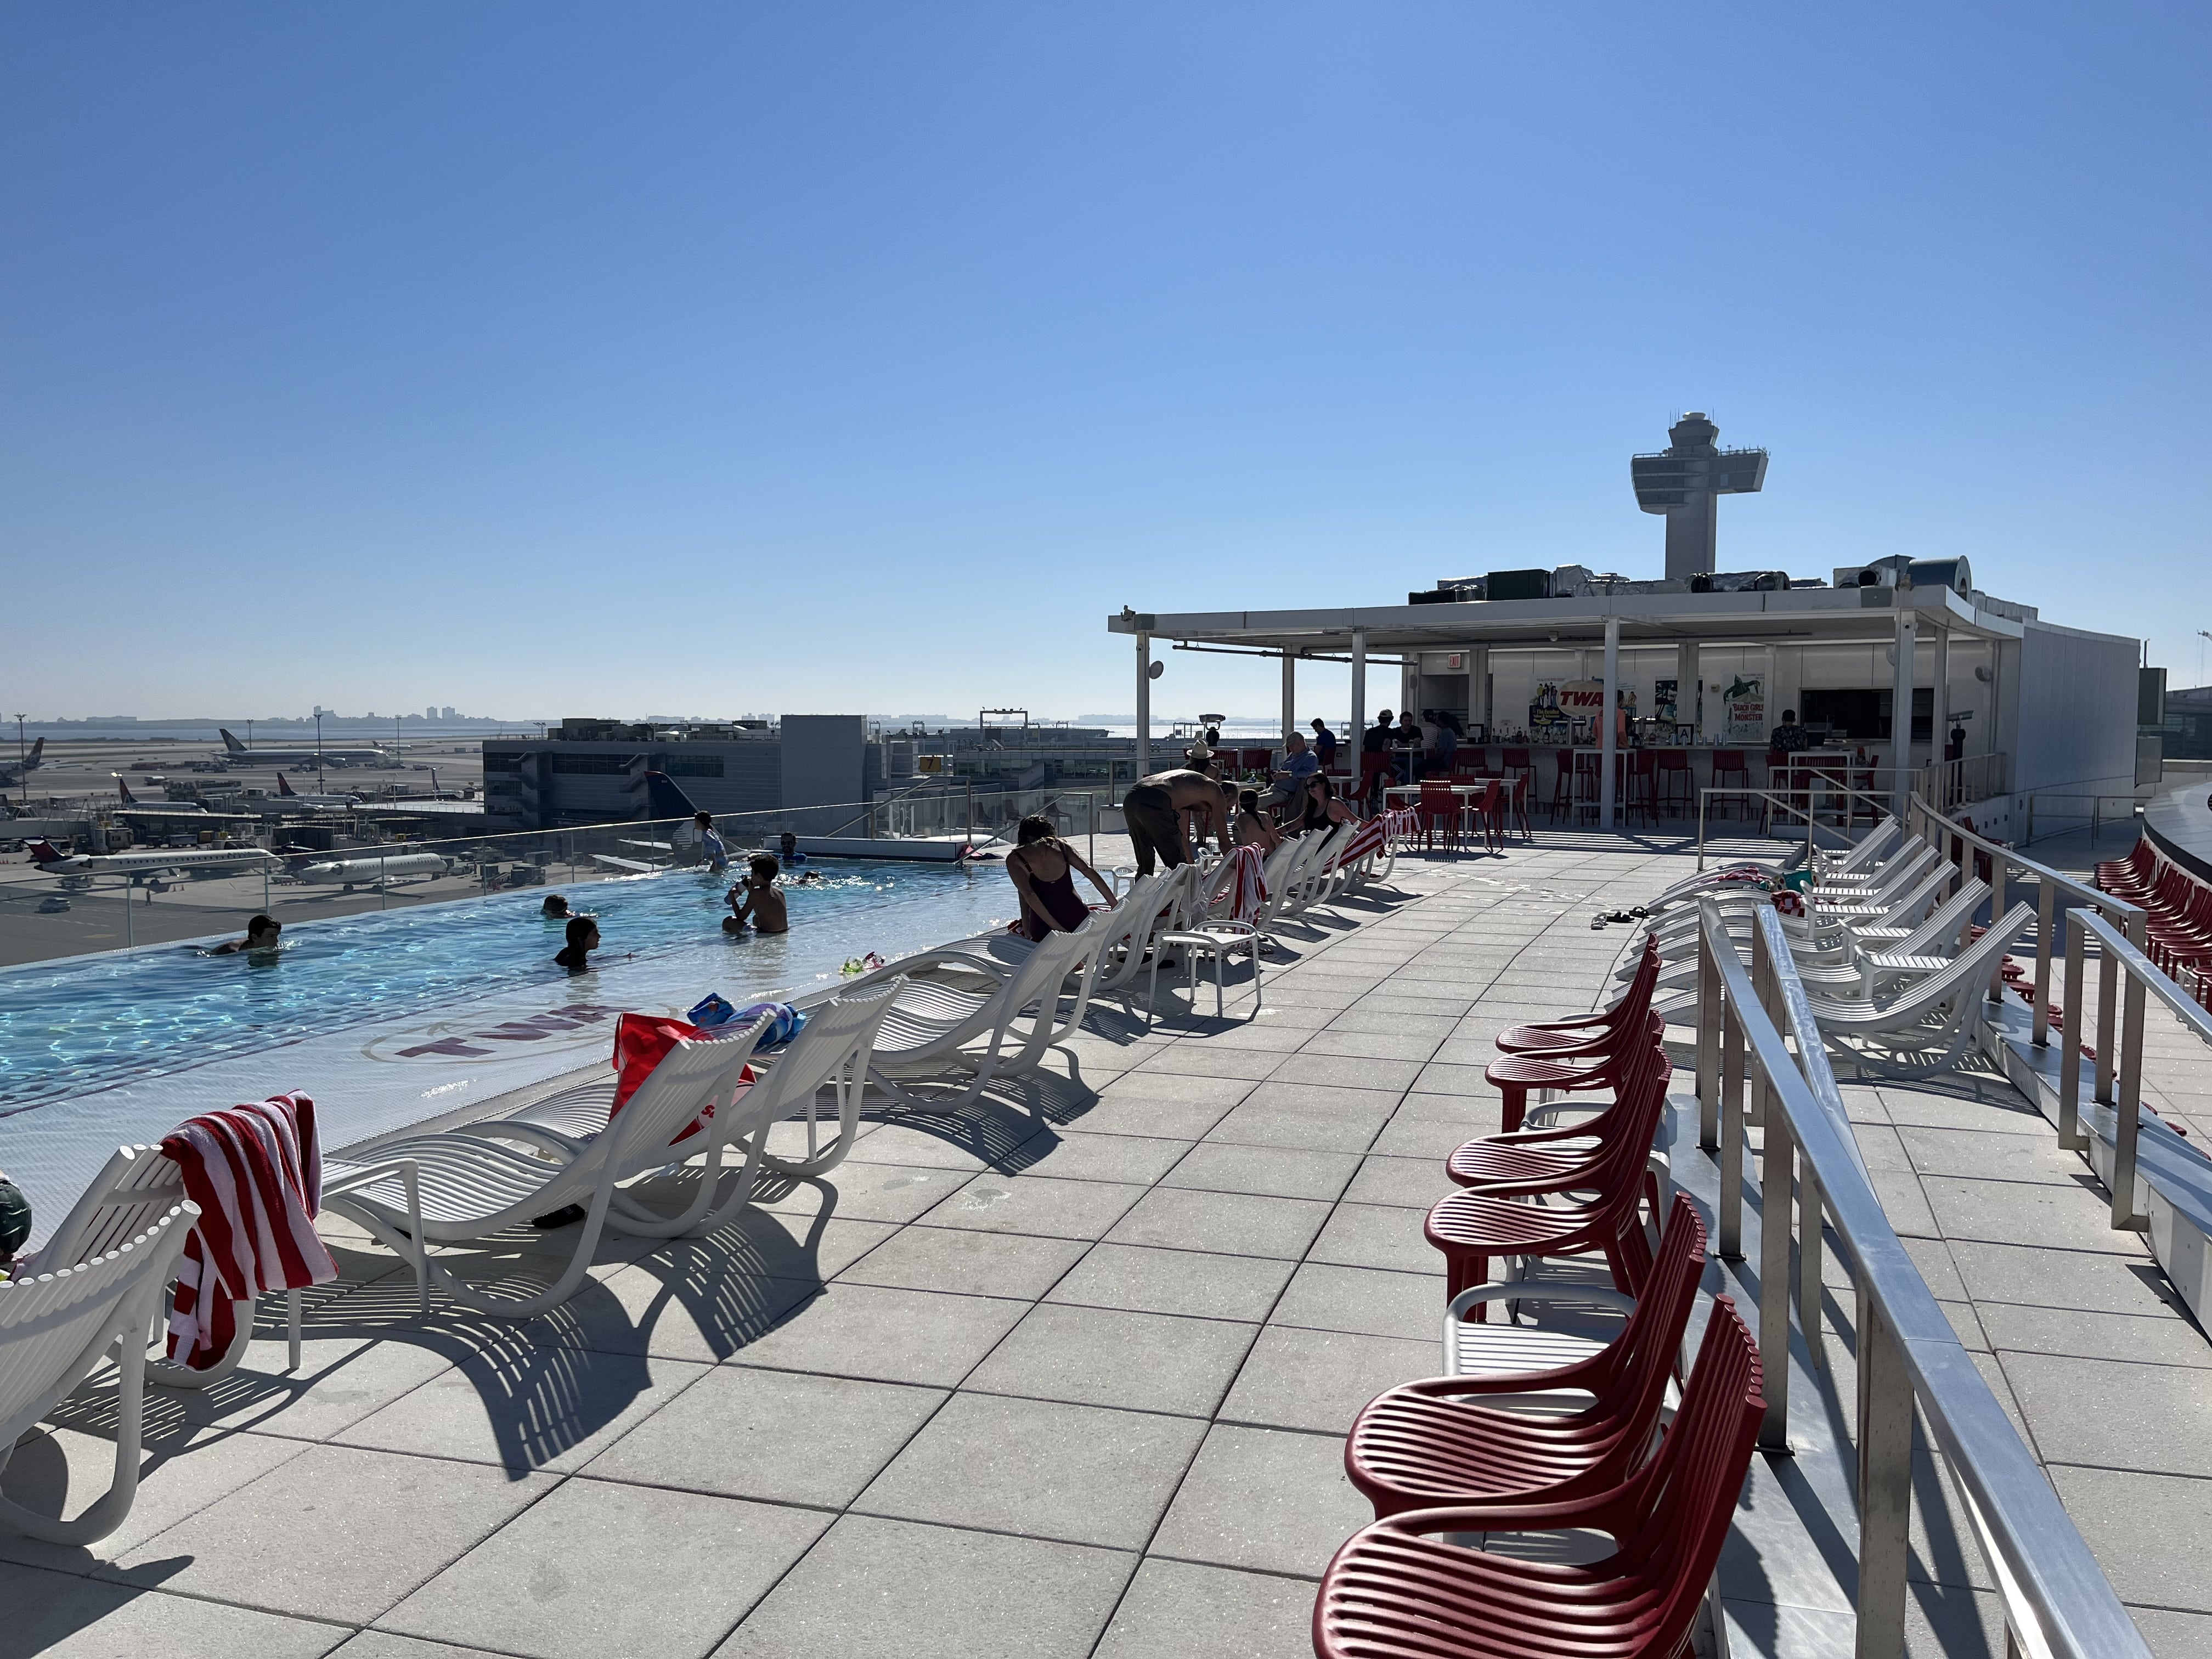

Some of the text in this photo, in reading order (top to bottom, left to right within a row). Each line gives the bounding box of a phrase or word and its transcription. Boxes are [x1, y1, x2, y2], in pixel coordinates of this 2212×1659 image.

[1449, 656, 1459, 667] EXIT
[1560, 691, 1604, 707] TWA
[1733, 703, 1749, 712] BEACH
[1680, 728, 1689, 738] A
[927, 759, 934, 769] 7
